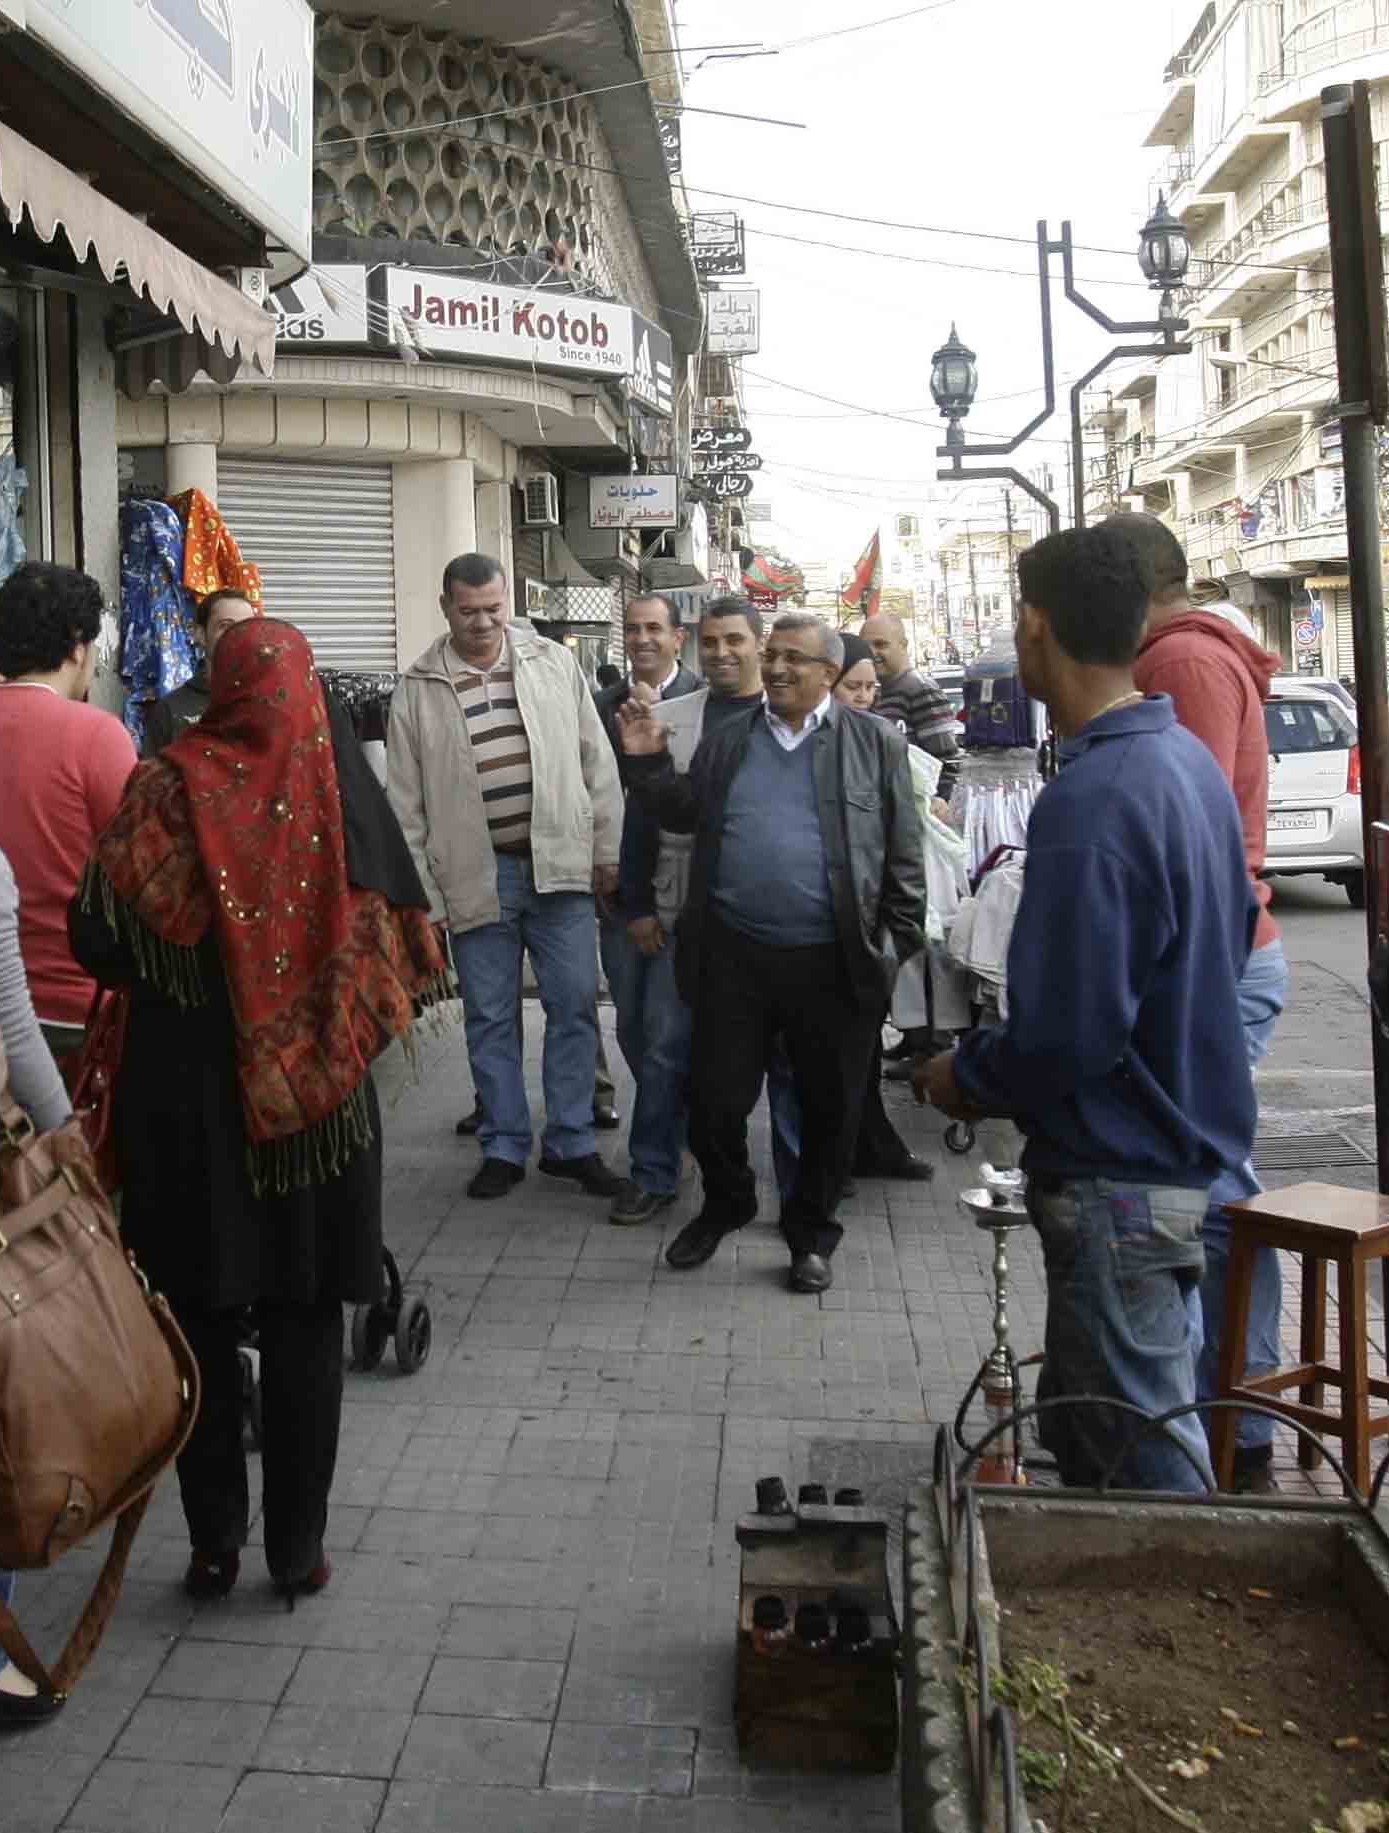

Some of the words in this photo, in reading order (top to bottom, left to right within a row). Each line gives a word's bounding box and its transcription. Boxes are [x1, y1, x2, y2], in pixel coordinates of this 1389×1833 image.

[408, 283, 500, 333] Jamil
[513, 300, 609, 348] Kotob
[559, 346, 591, 362] Since
[595, 351, 622, 366] 1940
[691, 429, 744, 449] معرض
[606, 484, 659, 502] حلويات
